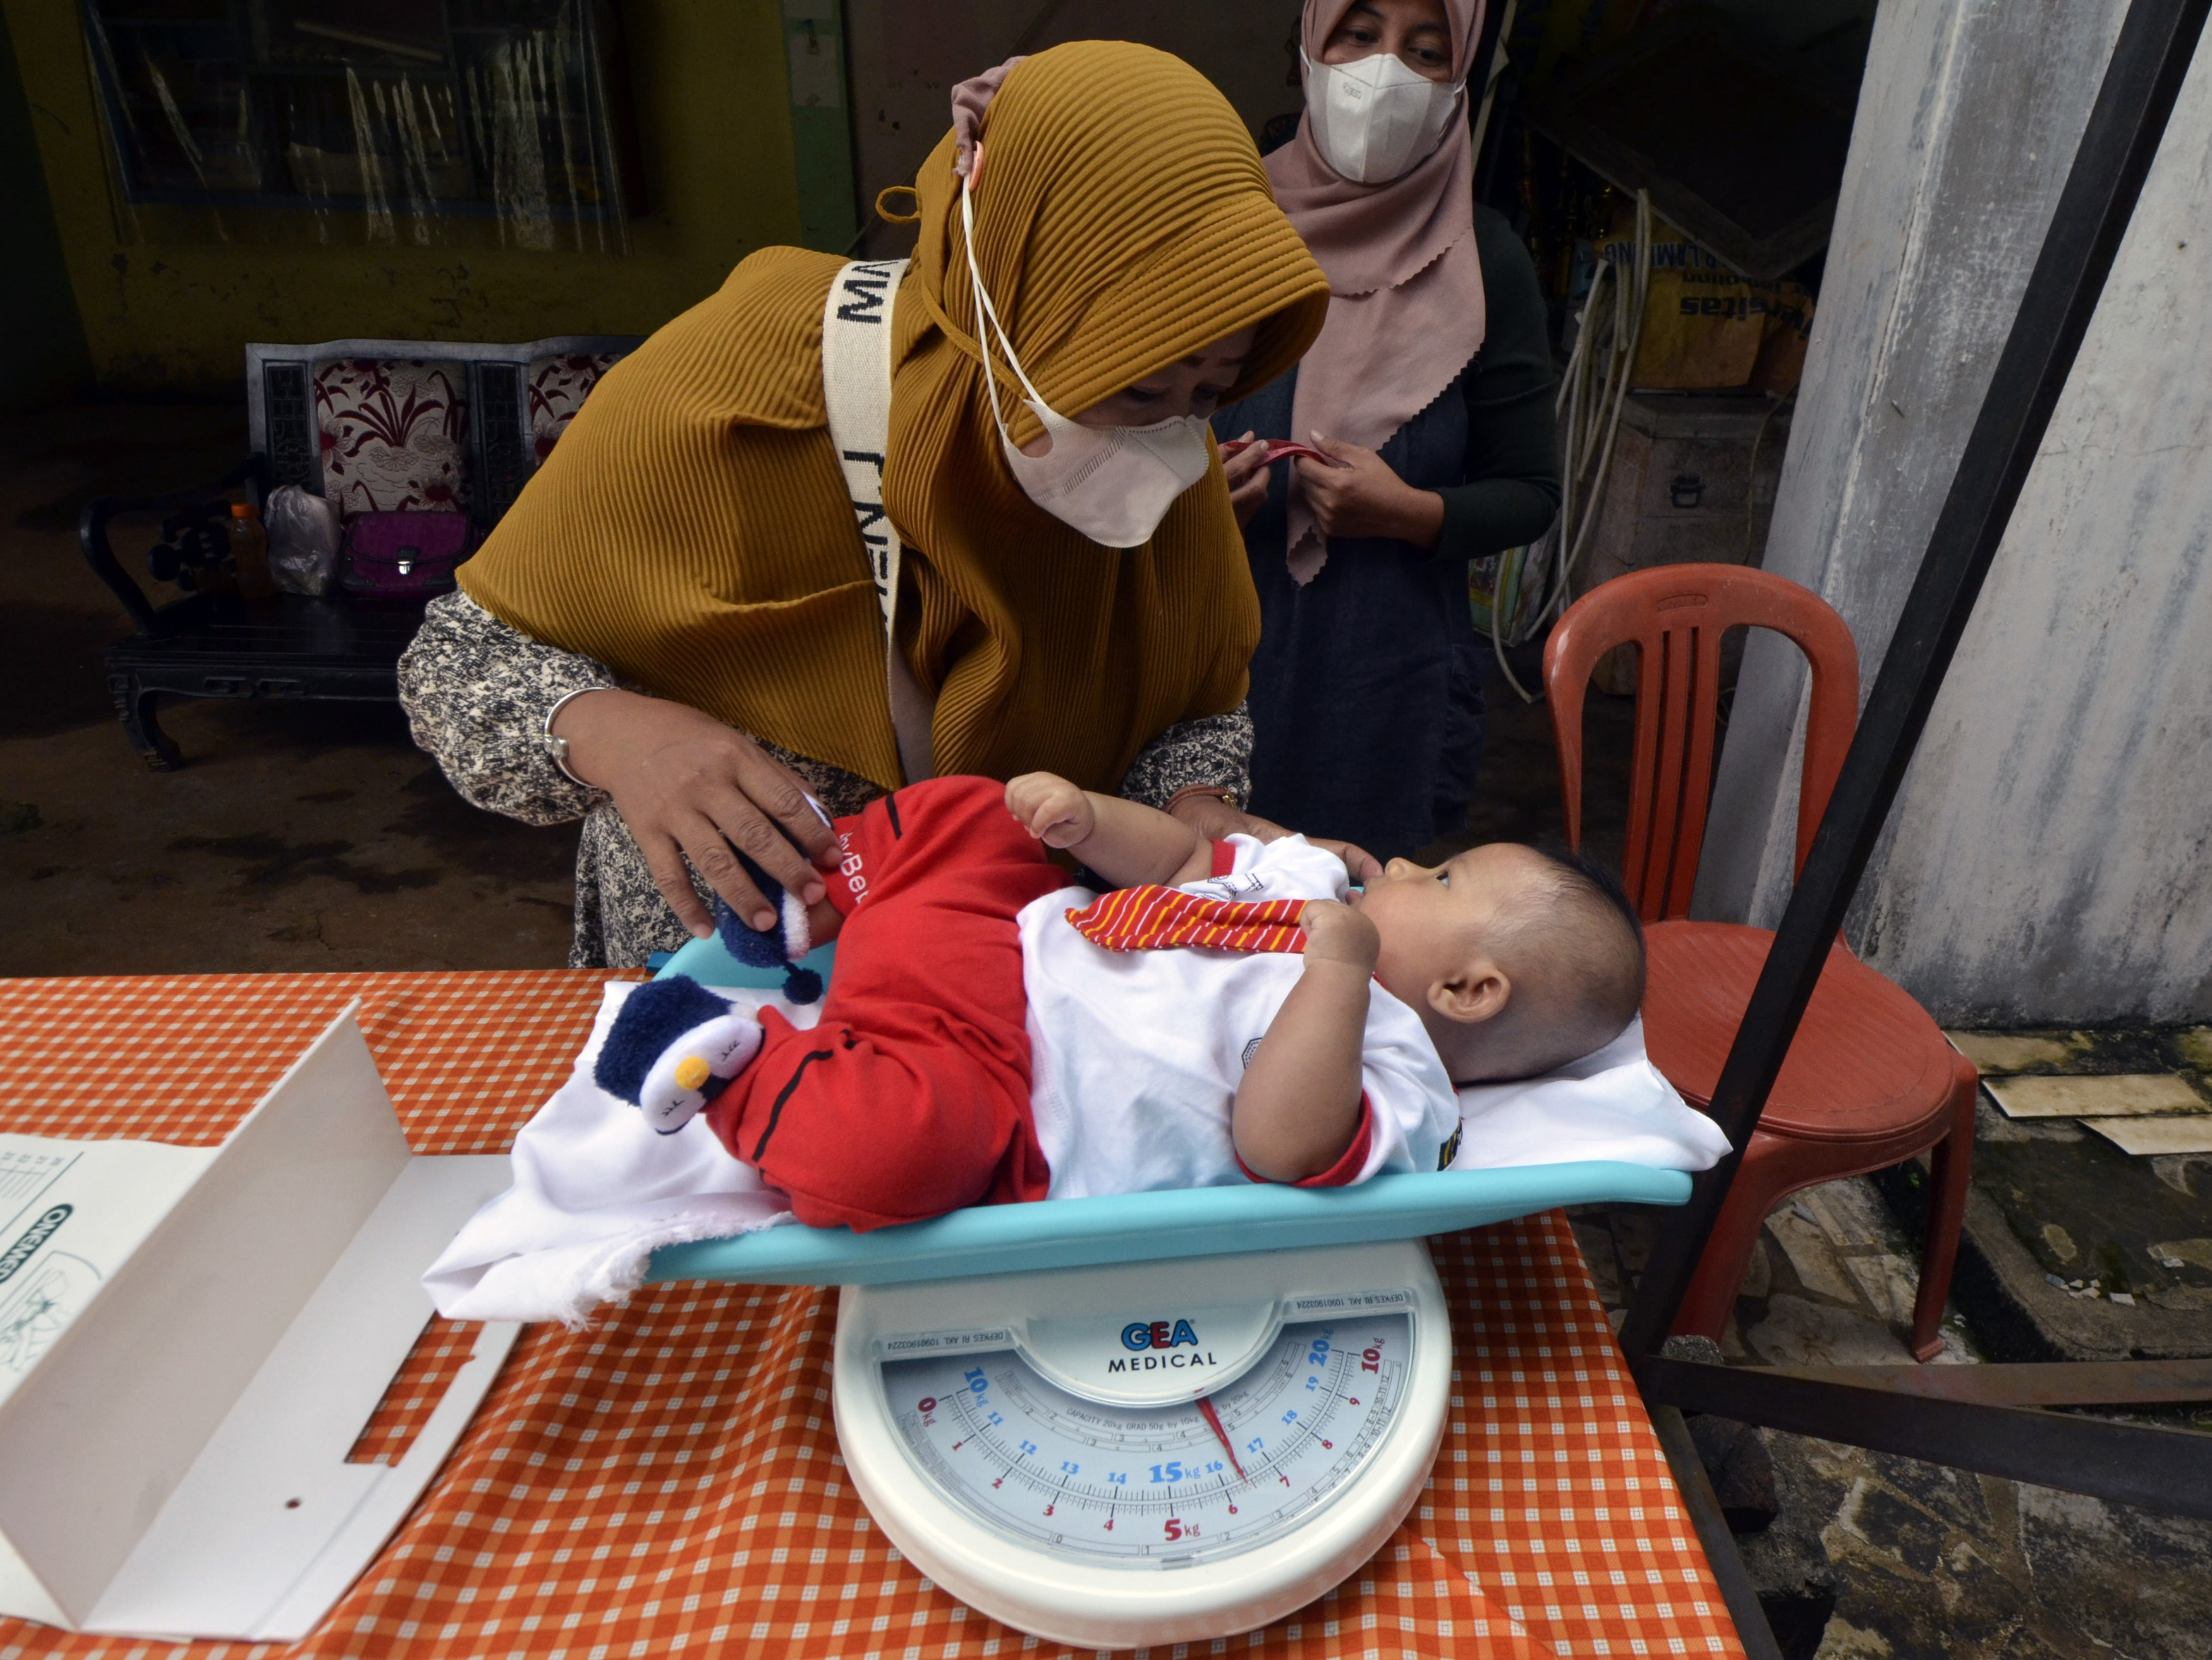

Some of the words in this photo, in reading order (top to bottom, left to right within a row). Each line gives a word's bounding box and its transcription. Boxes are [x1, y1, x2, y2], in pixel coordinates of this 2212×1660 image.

[1376, 1293, 1404, 1304] DEPKES
[944, 1336, 959, 1345] AKL
[974, 1332, 1003, 1342] DEPKES
[1121, 1319, 1198, 1351] GEA
[1108, 1352, 1217, 1373] MEDICAL
[1222, 1402, 1232, 1410] by
[1231, 1391, 1250, 1405] 20kg
[1382, 1406, 1392, 1416] 12
[988, 1412, 1004, 1426] 11
[1018, 1440, 1037, 1455] 12
[1060, 1461, 1079, 1475] 13
[1108, 1472, 1127, 1484] 14
[1205, 1460, 1223, 1474] 16
[1247, 1437, 1264, 1453] 17
[1282, 1410, 1297, 1426] 18
[1305, 1376, 1319, 1392] 19
[1067, 1407, 1102, 1425] CAPACITY
[1103, 1420, 1122, 1430] 20kg
[1126, 1421, 1146, 1430] GRAD
[1149, 1422, 1164, 1431] 50g
[1167, 1421, 1177, 1429] by
[1181, 1416, 1200, 1425] 10kg
[1090, 1438, 1097, 1446] 3
[1229, 1423, 1235, 1431] 5
[952, 1441, 963, 1451] 1
[992, 1477, 1004, 1489] 2
[1043, 1504, 1054, 1516] 3
[1103, 1518, 1114, 1531] 4
[1228, 1504, 1238, 1515] 6
[1279, 1475, 1291, 1487] 7
[1322, 1439, 1333, 1450] 8
[1349, 1397, 1361, 1405] 9
[1056, 1534, 1063, 1544] 0
[1145, 1545, 1150, 1556] 1
[1225, 1532, 1232, 1541] 2
[1275, 1510, 1283, 1518] 3
[1310, 1486, 1318, 1494] 4
[1382, 1375, 1390, 1384] 12
